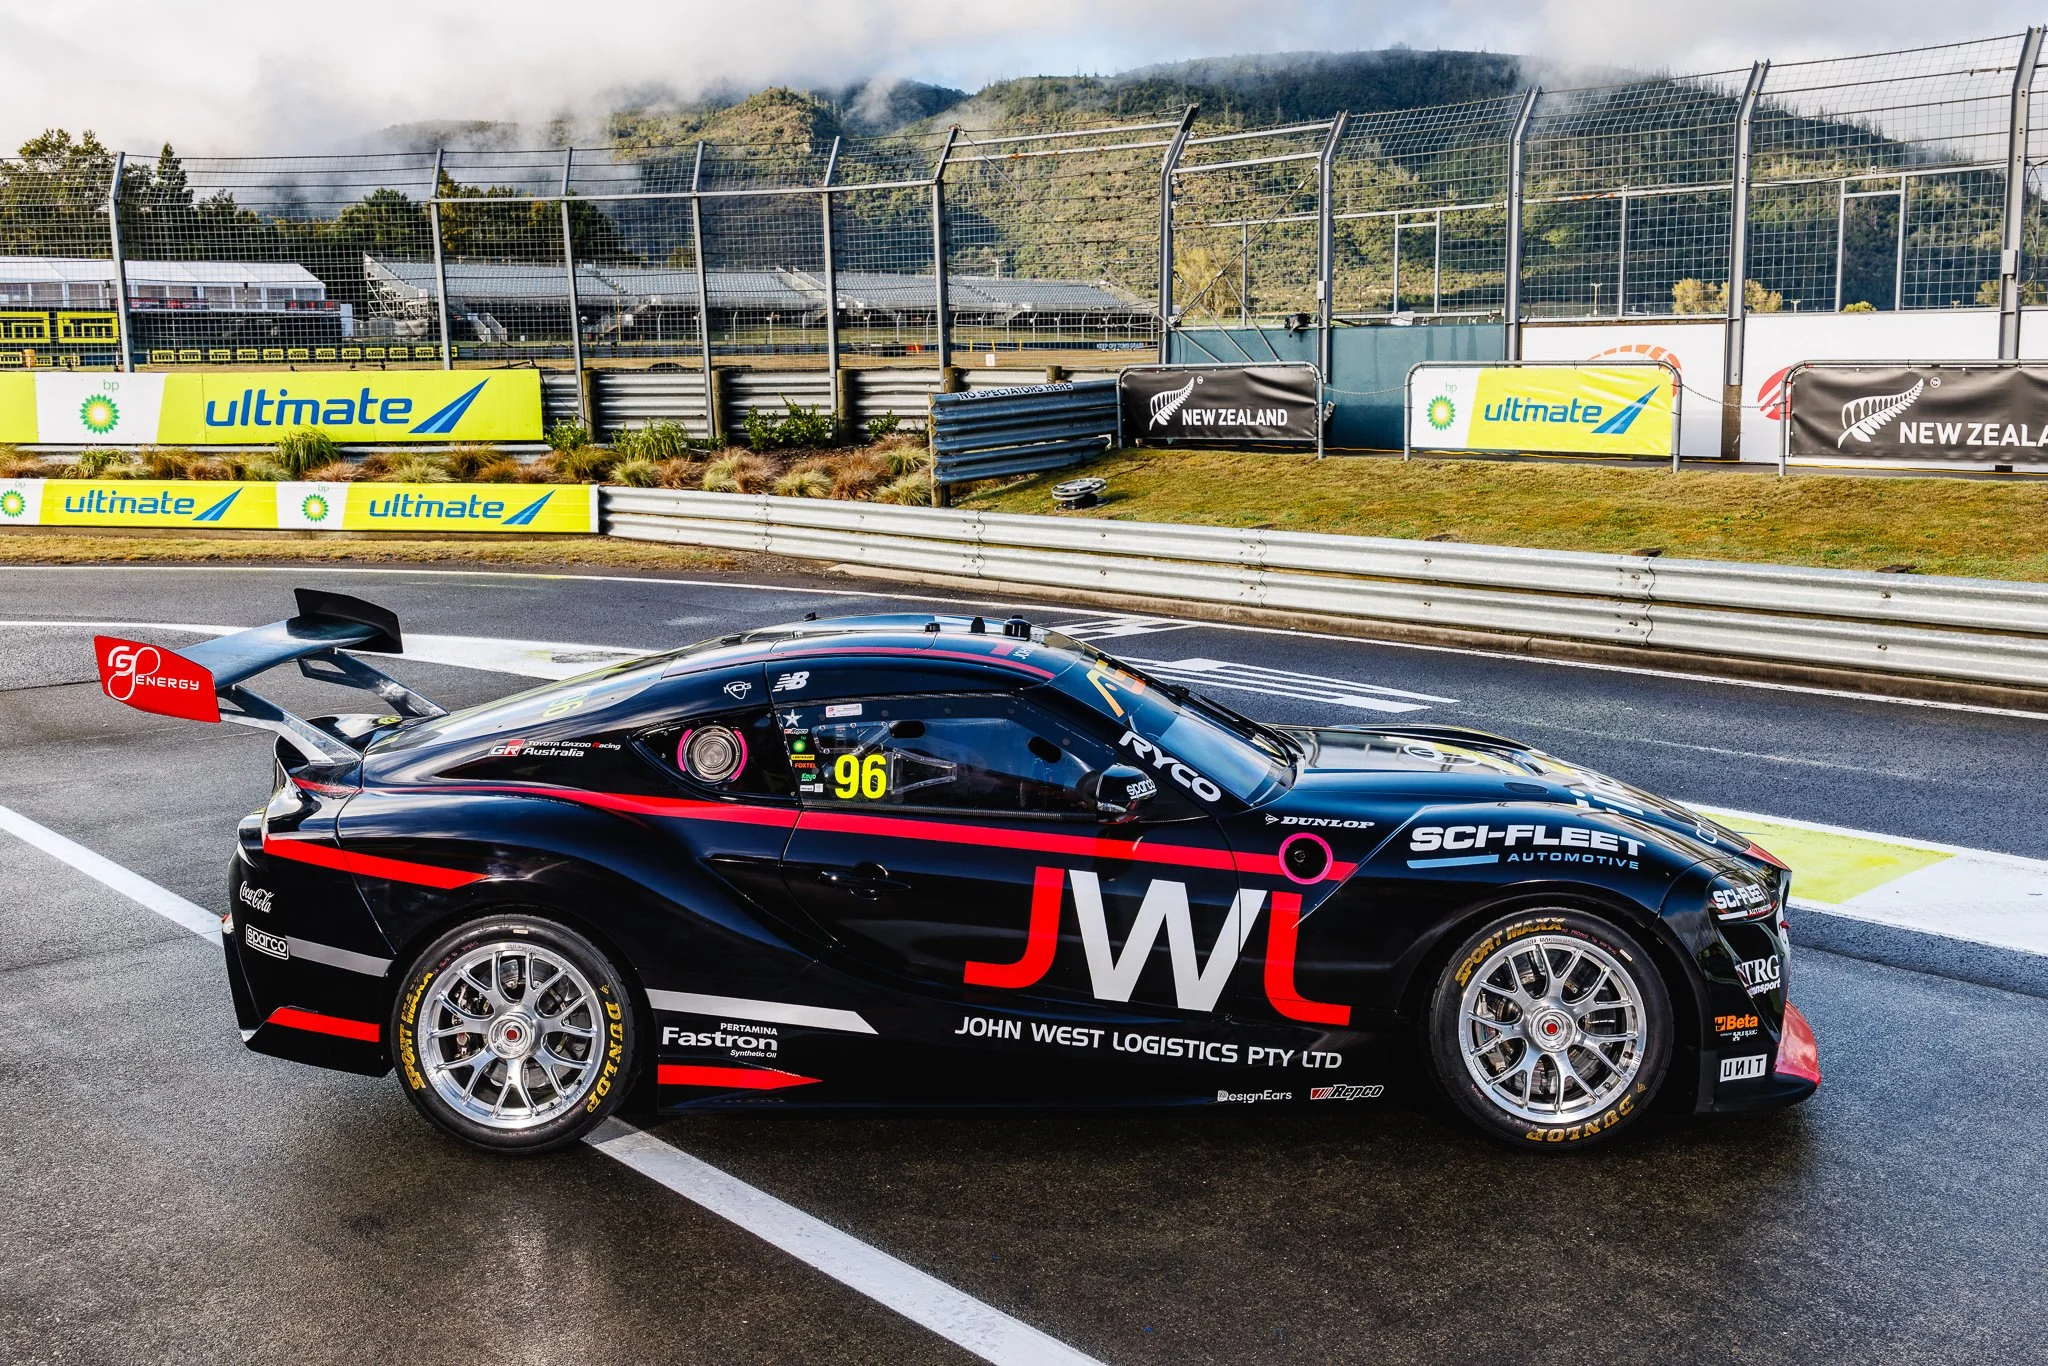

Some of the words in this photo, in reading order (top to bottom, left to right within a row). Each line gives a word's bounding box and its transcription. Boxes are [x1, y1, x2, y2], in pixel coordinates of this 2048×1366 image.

[103, 379, 120, 393] bp
[960, 391, 976, 400] NO
[979, 384, 1044, 399] SPECTATORS
[1044, 381, 1072, 392] HERE
[1445, 382, 1458, 393] bp
[205, 387, 413, 427] ultimate
[1182, 408, 1217, 426] NEW
[1217, 408, 1288, 426] ZEALAND
[1484, 396, 1603, 424] ultimate
[1899, 421, 1963, 445] NEW
[64, 489, 195, 515] ultimate
[369, 493, 505, 519] ultimate
[136, 675, 199, 691] ENERGY
[490, 745, 519, 756] GR
[523, 747, 585, 757] Australia
[592, 742, 621, 750] Racing
[834, 754, 887, 799] 96
[1118, 730, 1222, 802] RYCO
[1280, 816, 1375, 829] DUNLOP
[1410, 825, 1646, 856] SCI-FLEET
[1507, 852, 1639, 870] AUTOMOTIVE
[1713, 883, 1767, 910] SCI-FLEET
[247, 928, 287, 953] sparco
[963, 866, 1351, 1026] JWL
[1455, 930, 1503, 987] SPORT
[1506, 917, 1567, 940] MAXX
[720, 1022, 778, 1036] PERTAMINA
[1727, 1014, 1759, 1030] Beta
[662, 1026, 778, 1051] Fastron
[955, 1016, 1022, 1040] JOHN
[1031, 1022, 1105, 1048] WEST
[1112, 1031, 1239, 1063] LOGISTICS
[1247, 1046, 1295, 1067] PTY
[1301, 1050, 1343, 1069] LTD
[399, 1023, 427, 1090] SPORT
[586, 1001, 624, 1113] DUNLOP
[730, 1050, 765, 1058] Synthetic
[1331, 1084, 1384, 1101] Repco
[1526, 1094, 1635, 1142] DUNLOP
